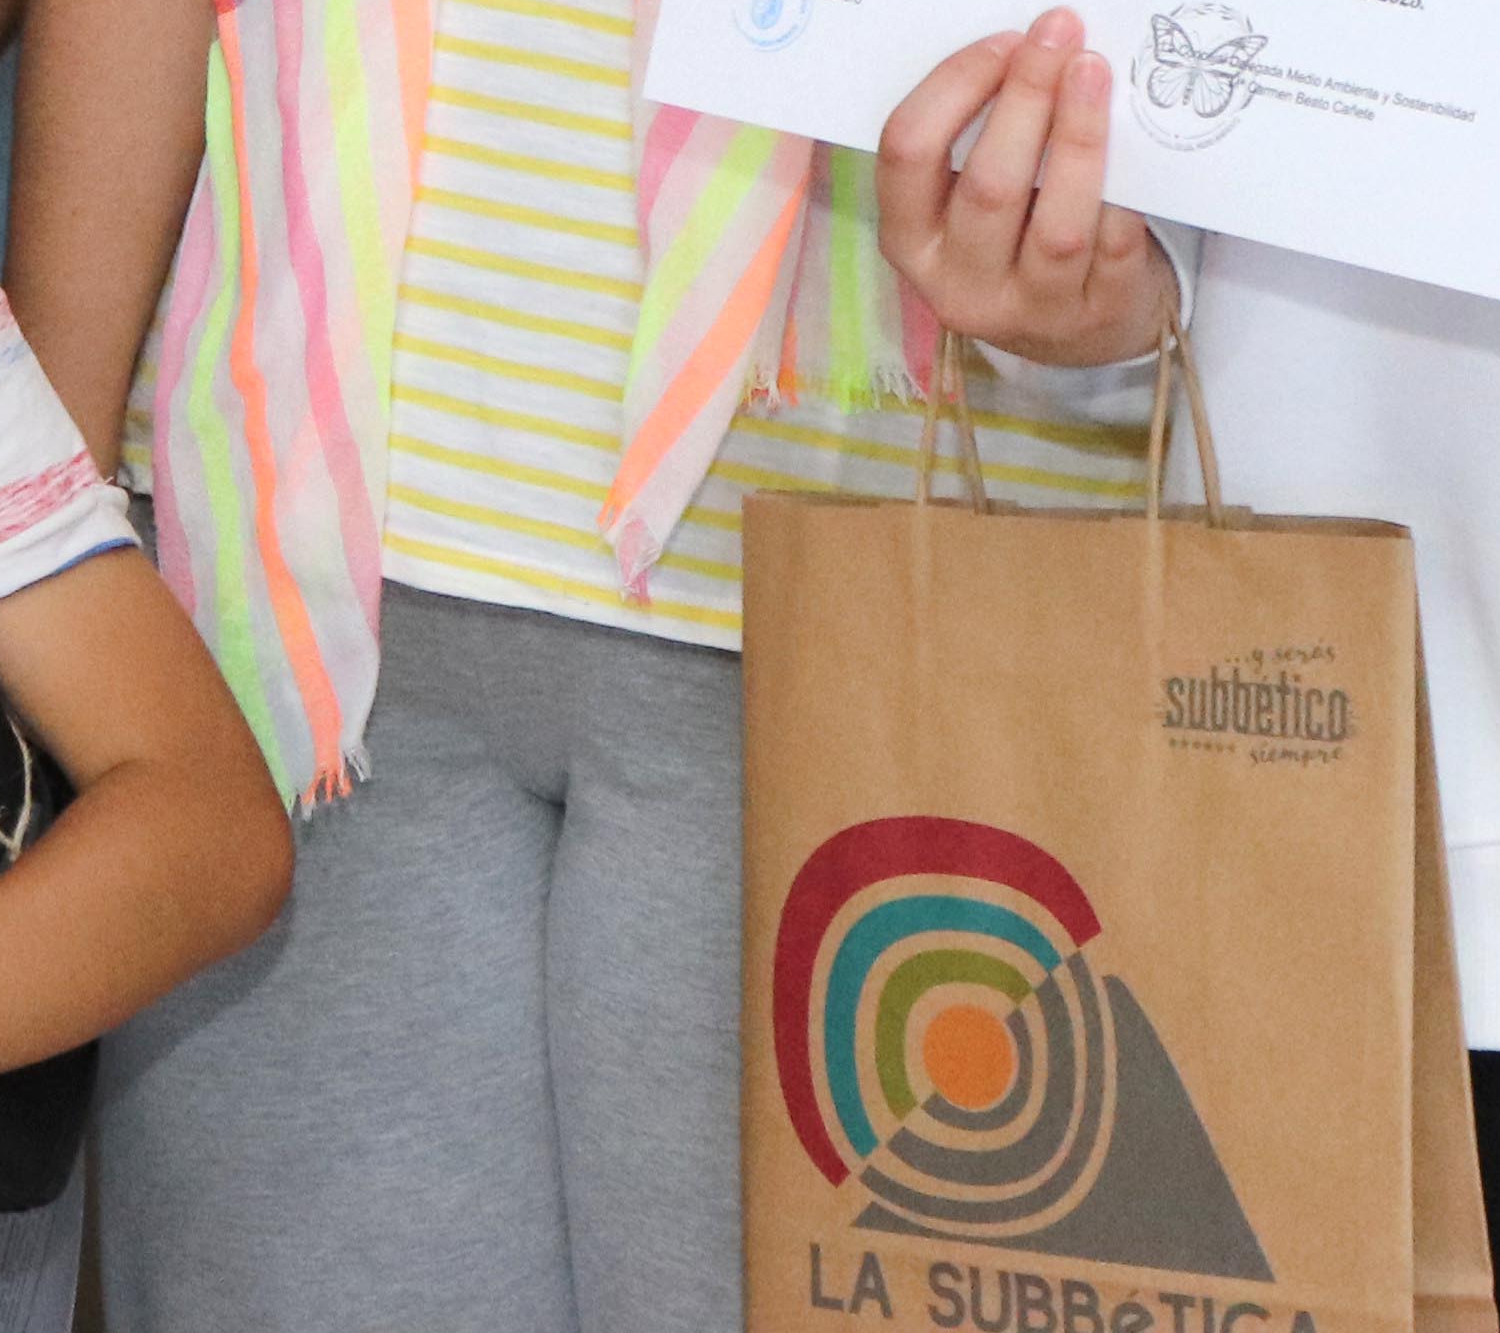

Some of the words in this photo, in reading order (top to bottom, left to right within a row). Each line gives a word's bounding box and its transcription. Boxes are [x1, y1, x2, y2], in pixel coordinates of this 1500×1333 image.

[1249, 80, 1293, 101] Carmen
[1286, 67, 1322, 87] Medio
[1324, 76, 1380, 101] Ambiente
[1381, 91, 1390, 105] y
[1392, 92, 1478, 123] Sostenibilidad
[1165, 665, 1348, 742] subbético
[808, 1241, 894, 1320] LA
